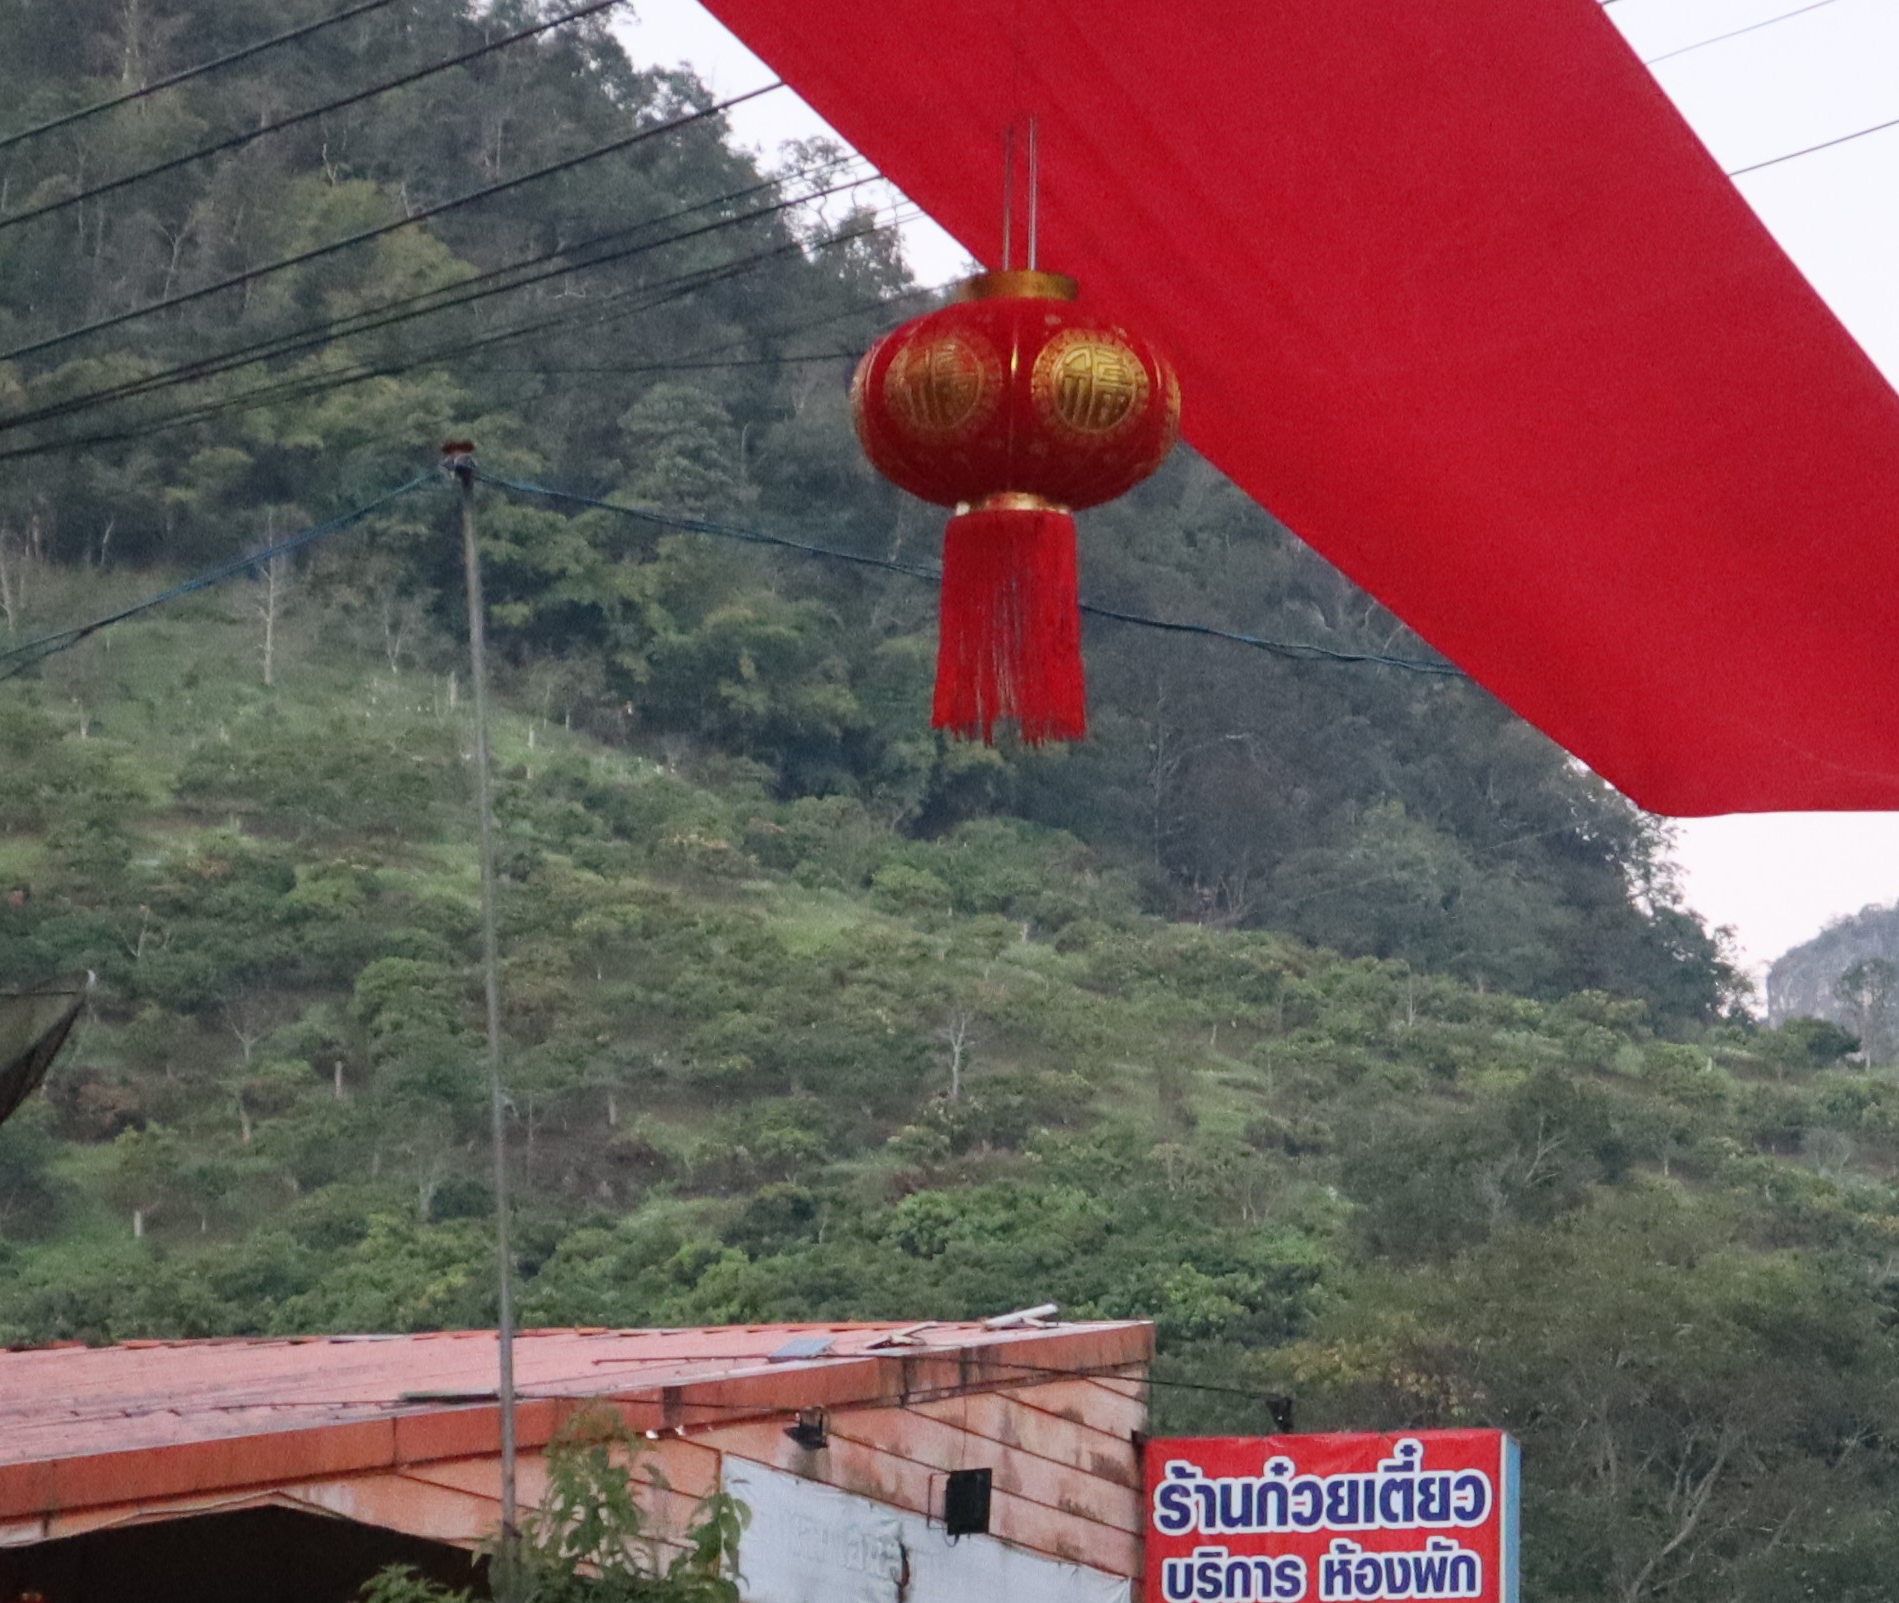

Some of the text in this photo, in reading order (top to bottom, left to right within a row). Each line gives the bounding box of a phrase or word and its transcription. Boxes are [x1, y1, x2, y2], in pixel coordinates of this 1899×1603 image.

[1155, 1440, 1489, 1533] ร้านก๋วยเตี๋ยว
[1164, 1537, 1480, 1603] บริการ ห้องพัก
